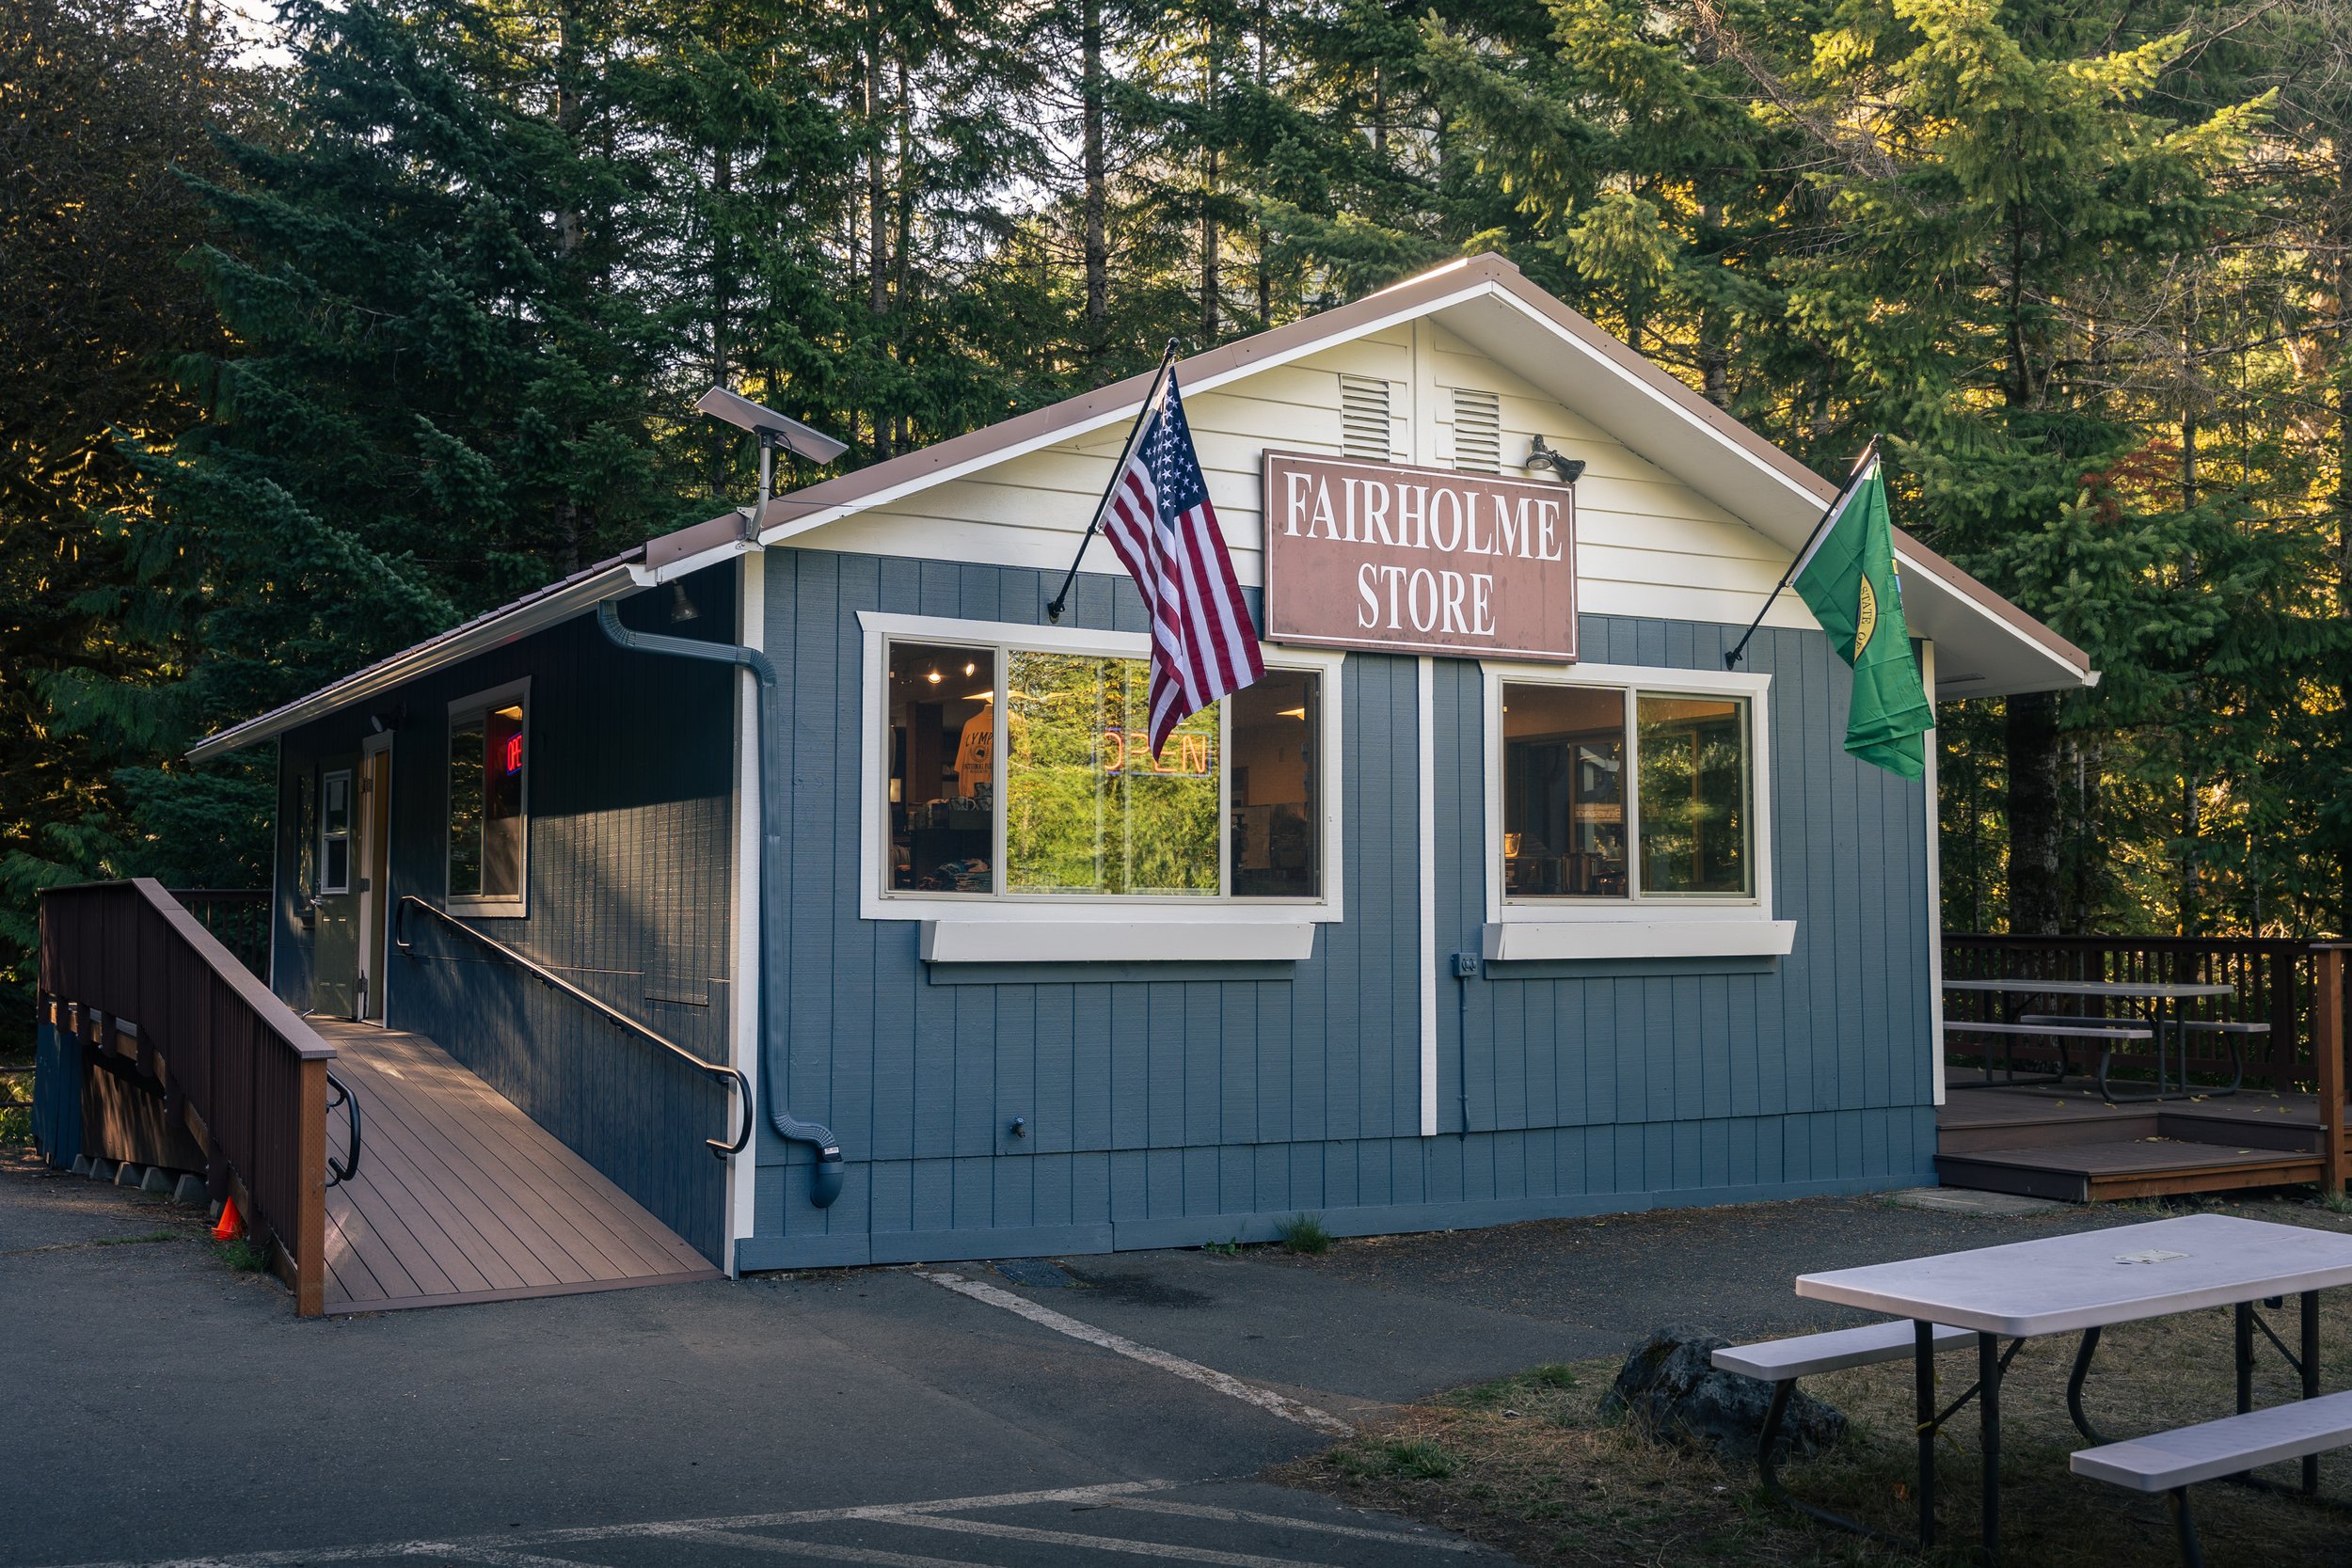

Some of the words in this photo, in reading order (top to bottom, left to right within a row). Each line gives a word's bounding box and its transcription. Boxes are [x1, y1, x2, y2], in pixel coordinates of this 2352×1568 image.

[1282, 471, 1563, 562] FAIRHOLME
[1358, 562, 1496, 637] STORE
[1861, 586, 1872, 625] STATE
[1857, 631, 1867, 650] OF
